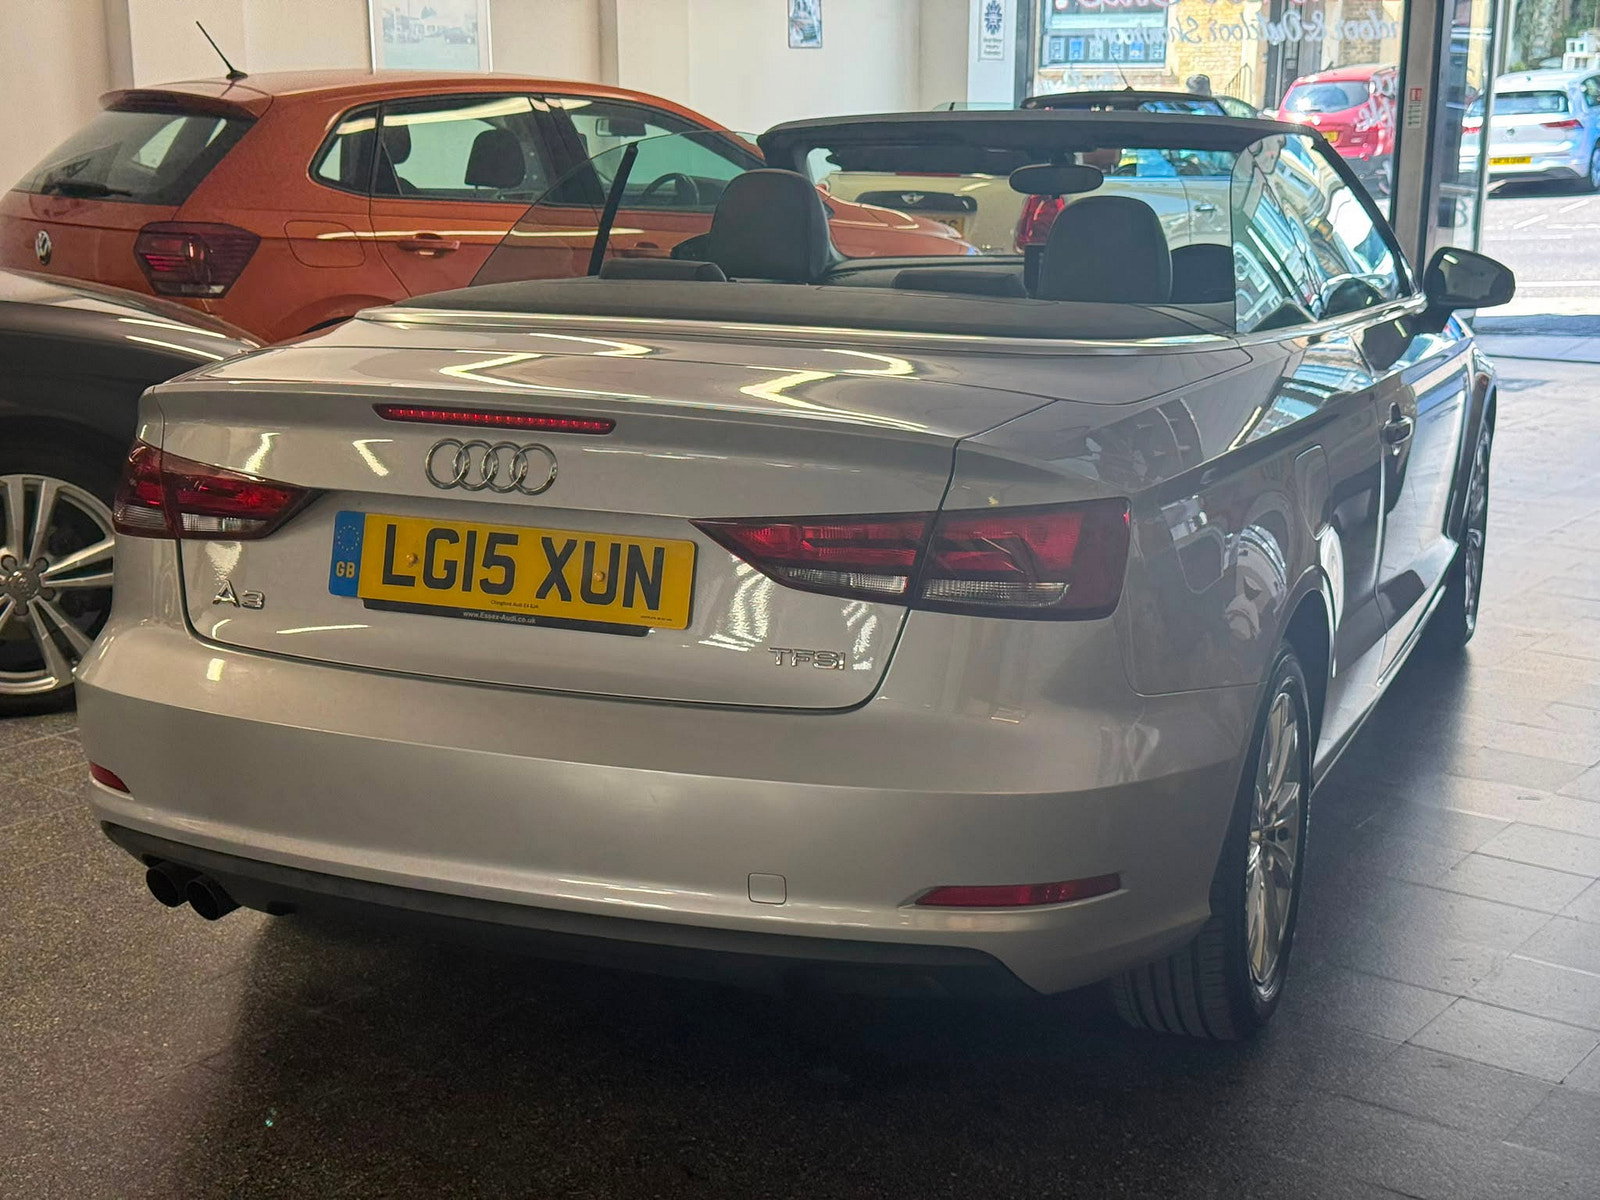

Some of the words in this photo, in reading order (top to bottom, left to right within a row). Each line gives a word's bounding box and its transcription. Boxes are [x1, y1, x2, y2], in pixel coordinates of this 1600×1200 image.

[335, 561, 356, 579] GB
[382, 524, 519, 596] LG15
[535, 537, 666, 611] XUN
[213, 579, 266, 609] A3
